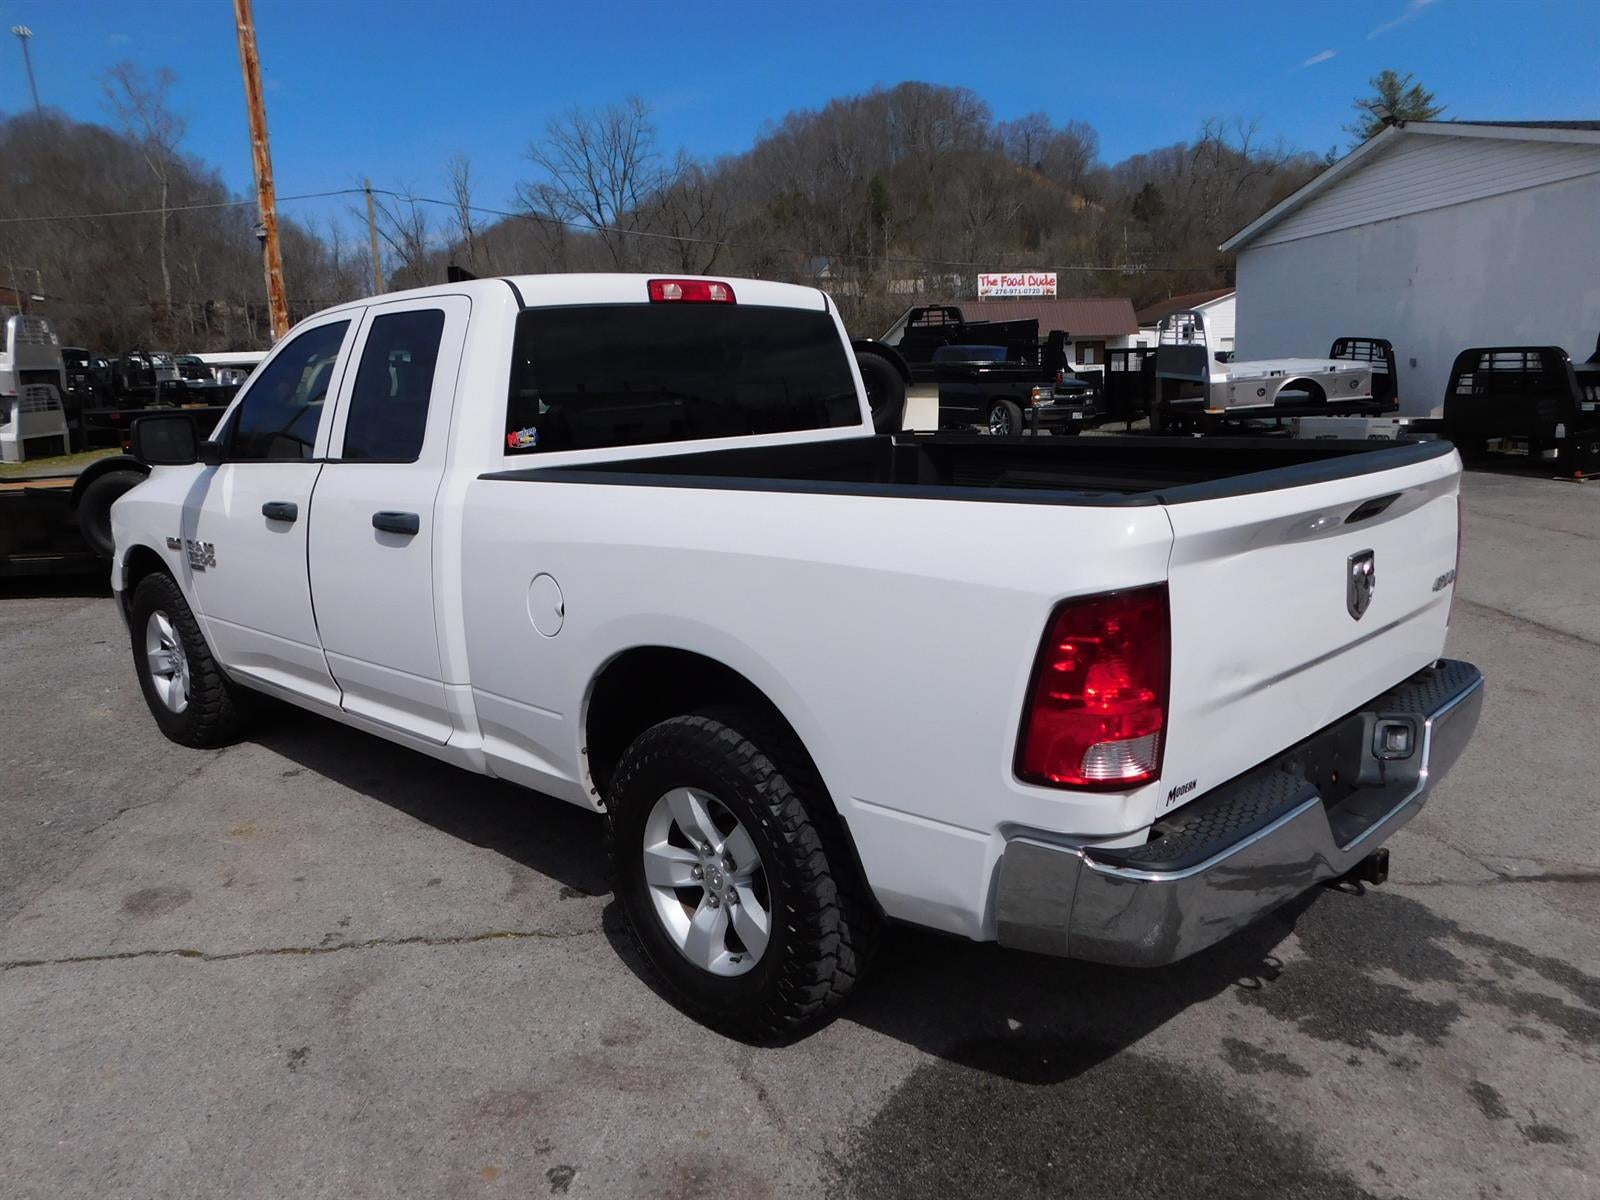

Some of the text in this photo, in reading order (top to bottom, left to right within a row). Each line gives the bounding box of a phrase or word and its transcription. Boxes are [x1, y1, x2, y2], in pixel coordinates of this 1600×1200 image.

[979, 274, 1056, 287] The Food Dude
